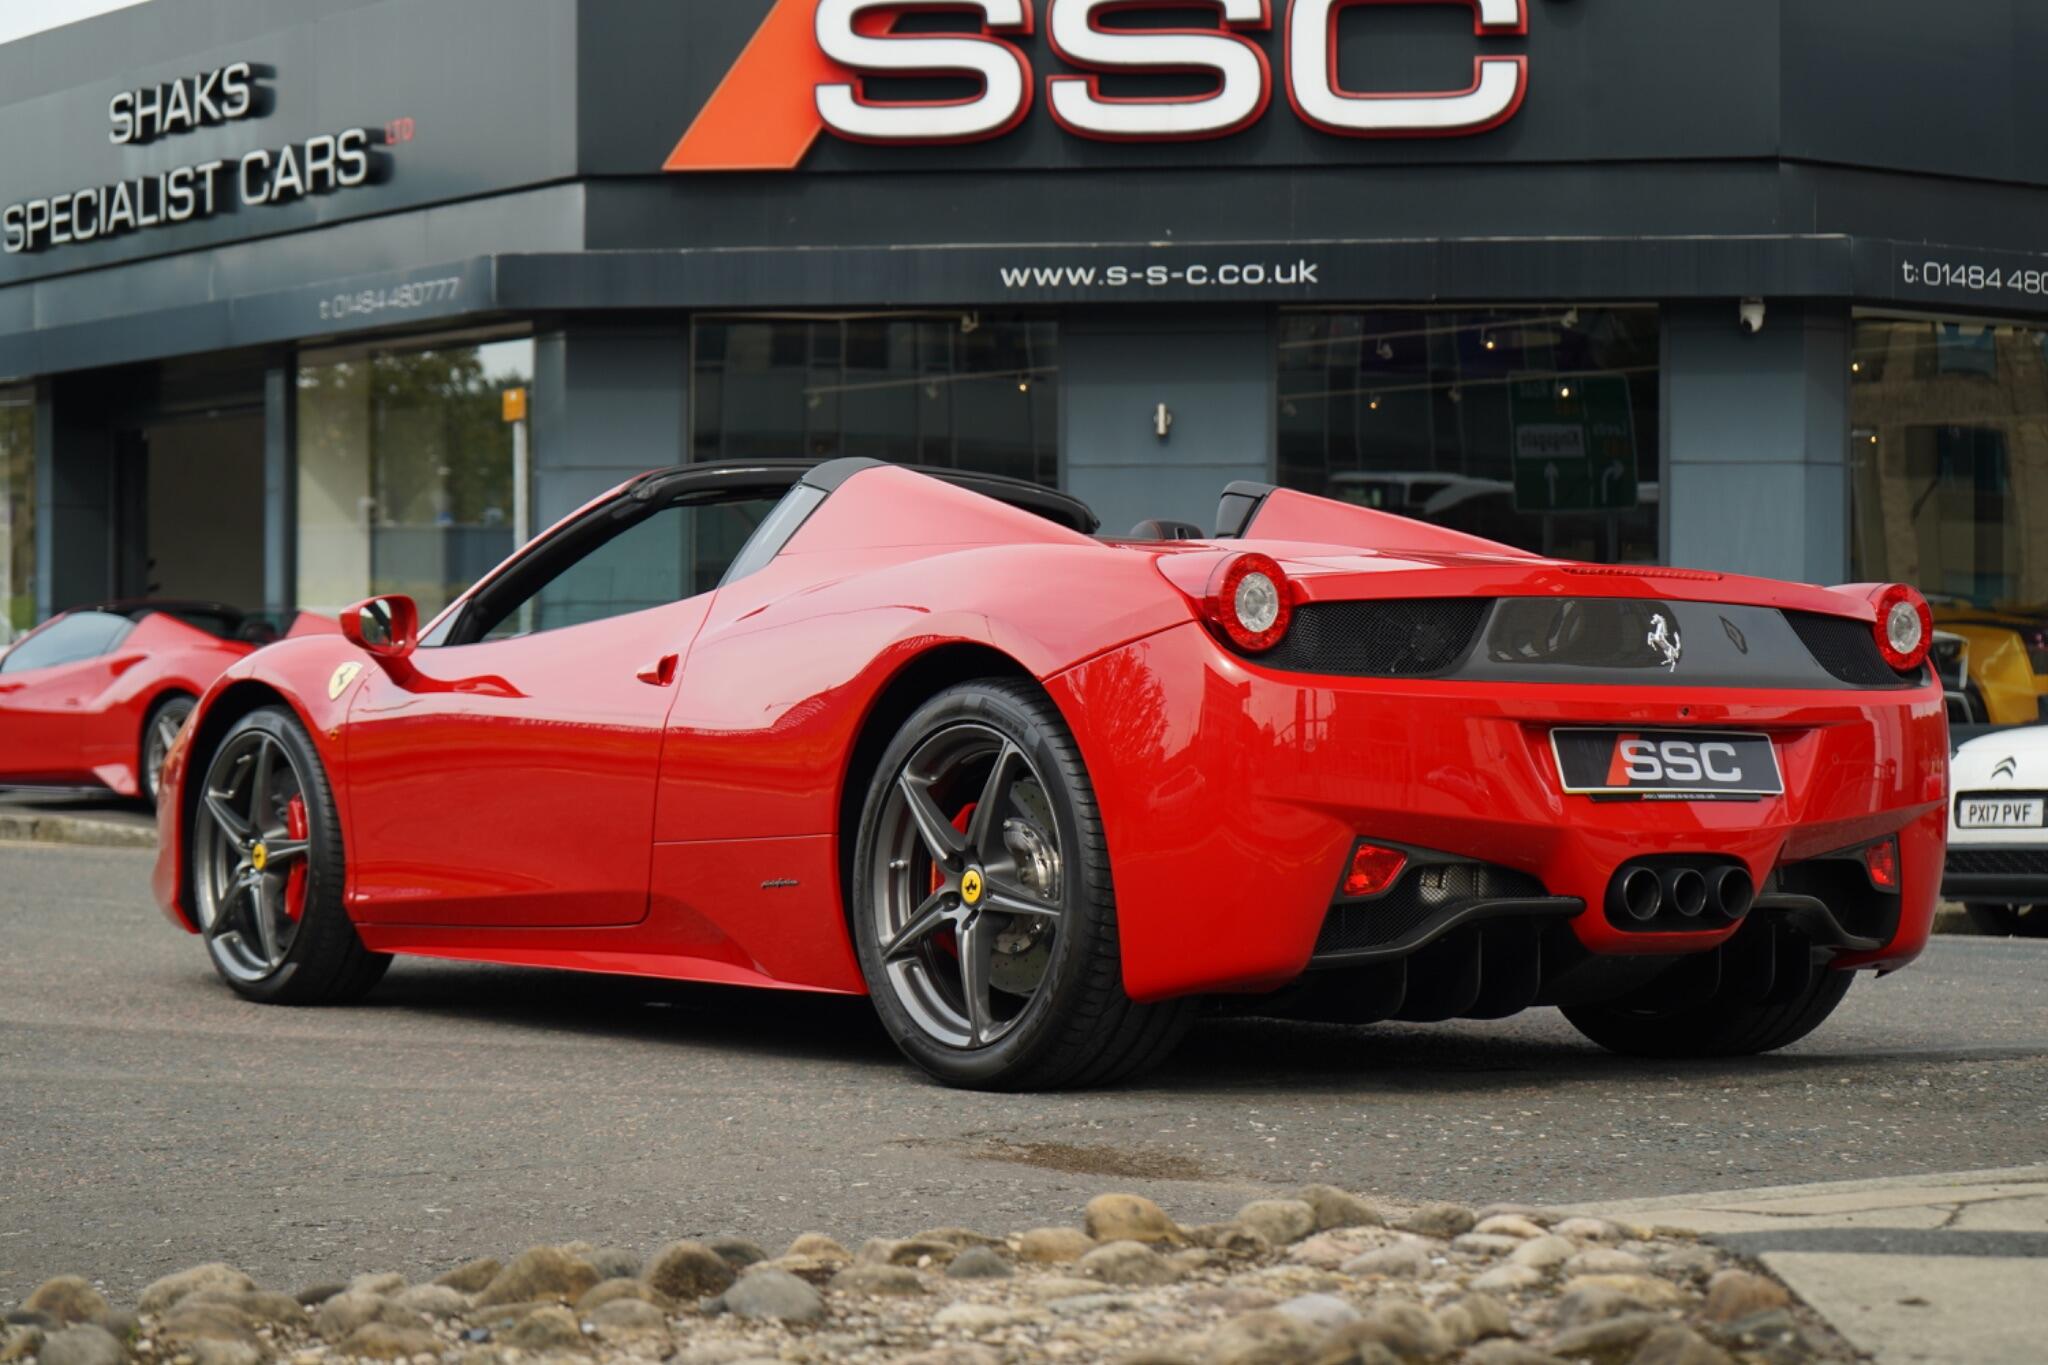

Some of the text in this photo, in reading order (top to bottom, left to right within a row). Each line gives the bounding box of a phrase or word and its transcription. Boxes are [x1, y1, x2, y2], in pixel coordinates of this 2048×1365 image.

[814, 0, 1526, 145] SSC
[108, 62, 251, 145] SHAKS
[385, 117, 415, 144] LTD
[2, 128, 367, 253] SPECIALIST CARS
[1000, 259, 1319, 287] www.s-s-c.co.uk
[1923, 261, 2002, 289] 01484
[1620, 740, 1742, 782] SSC
[1968, 803, 2032, 823] PX17 PVF
